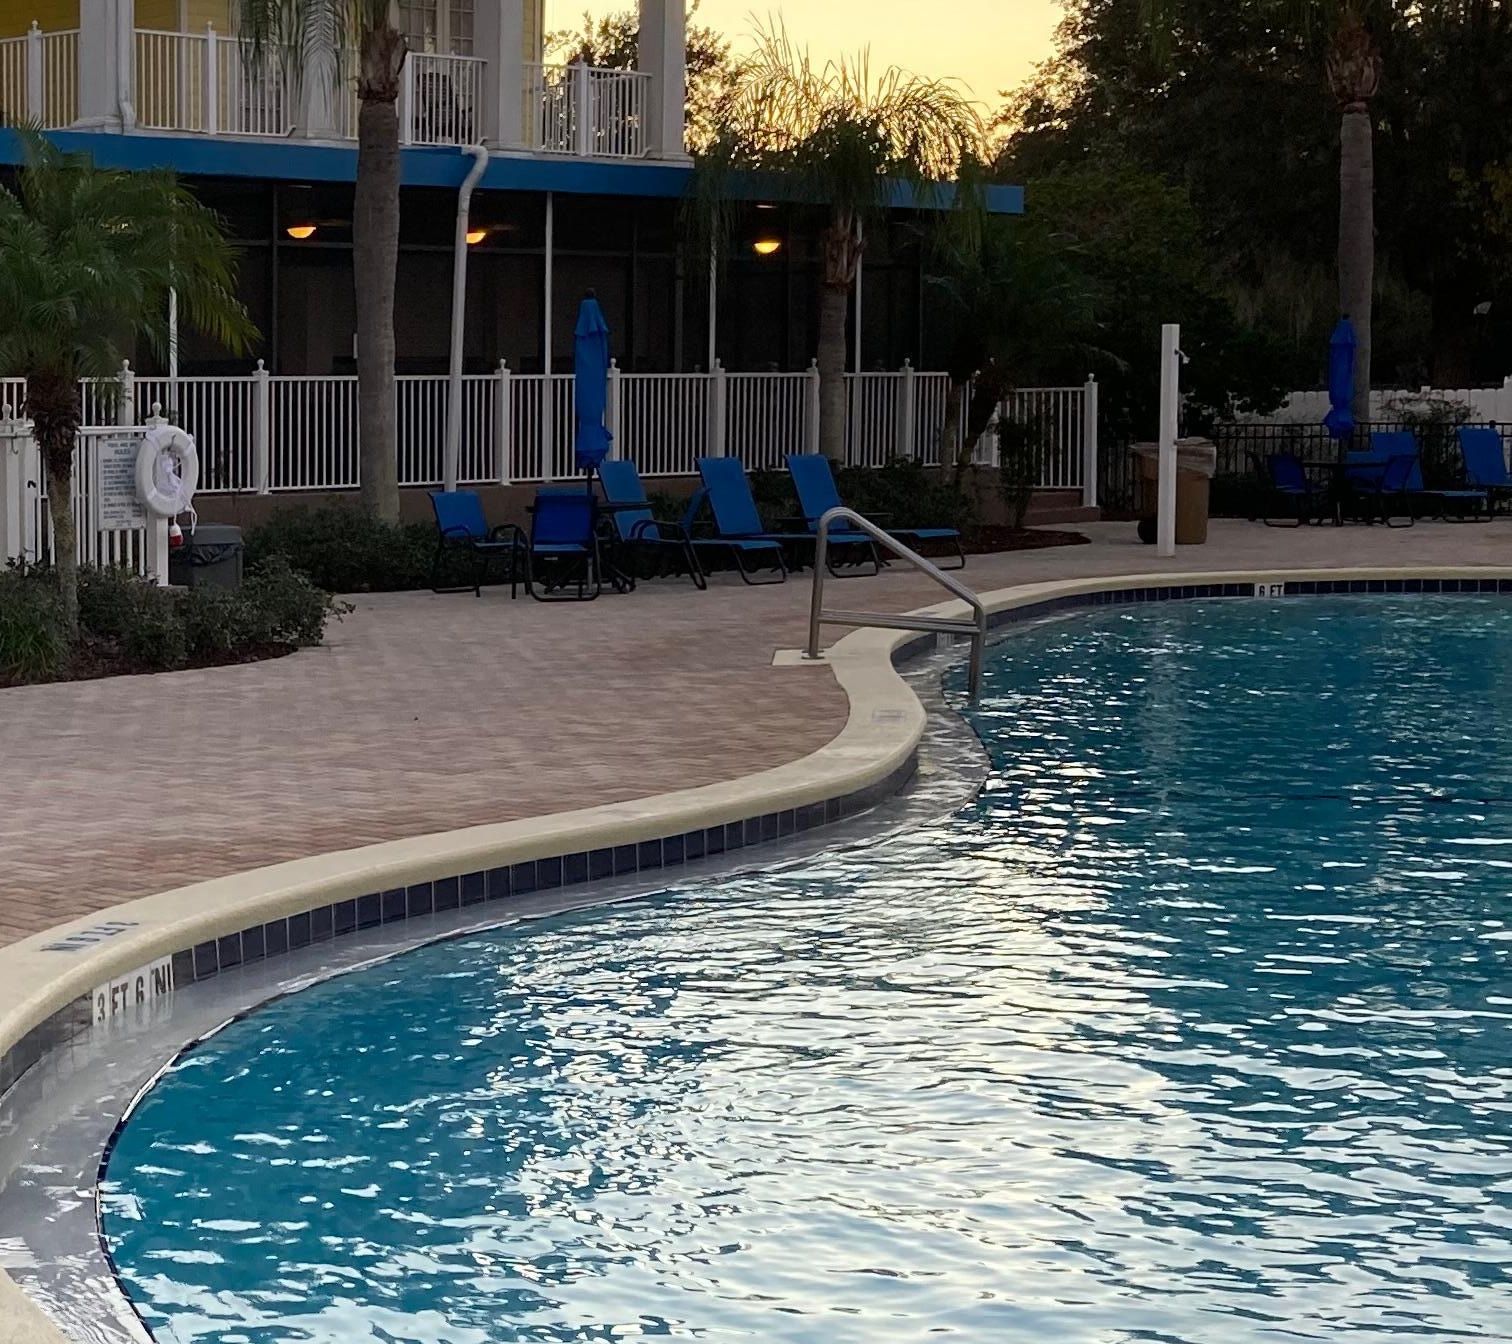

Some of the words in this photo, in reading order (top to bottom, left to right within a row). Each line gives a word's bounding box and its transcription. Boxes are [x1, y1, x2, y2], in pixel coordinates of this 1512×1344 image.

[1270, 584, 1283, 597] FT
[97, 992, 106, 1023] 3
[112, 982, 128, 1016] FT
[135, 975, 144, 1004] 6
